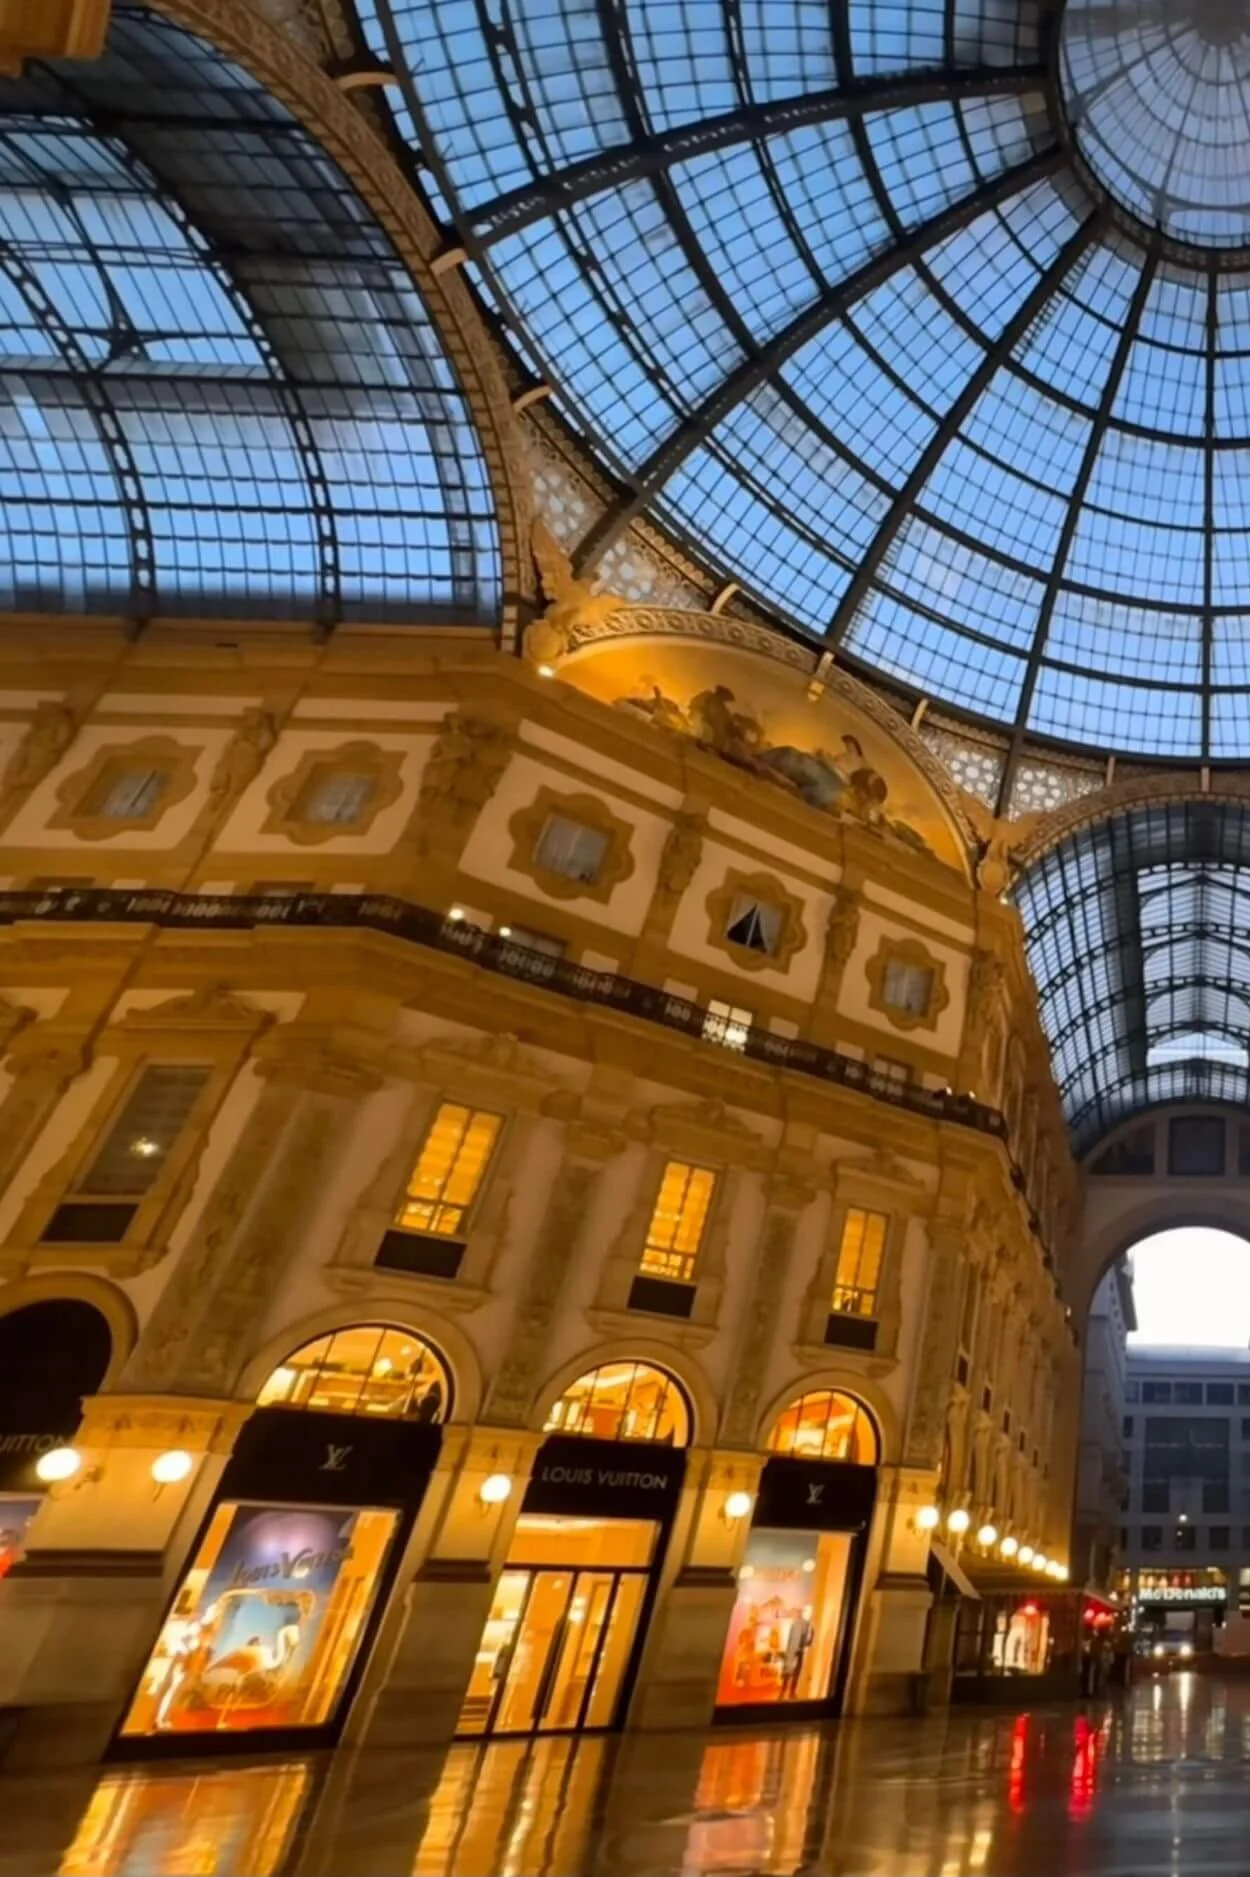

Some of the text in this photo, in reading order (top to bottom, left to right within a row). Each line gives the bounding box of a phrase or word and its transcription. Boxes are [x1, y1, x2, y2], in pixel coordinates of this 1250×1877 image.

[541, 1466, 668, 1490] LOUIS VUITTON
[1138, 1587, 1226, 1600] McDonald's
